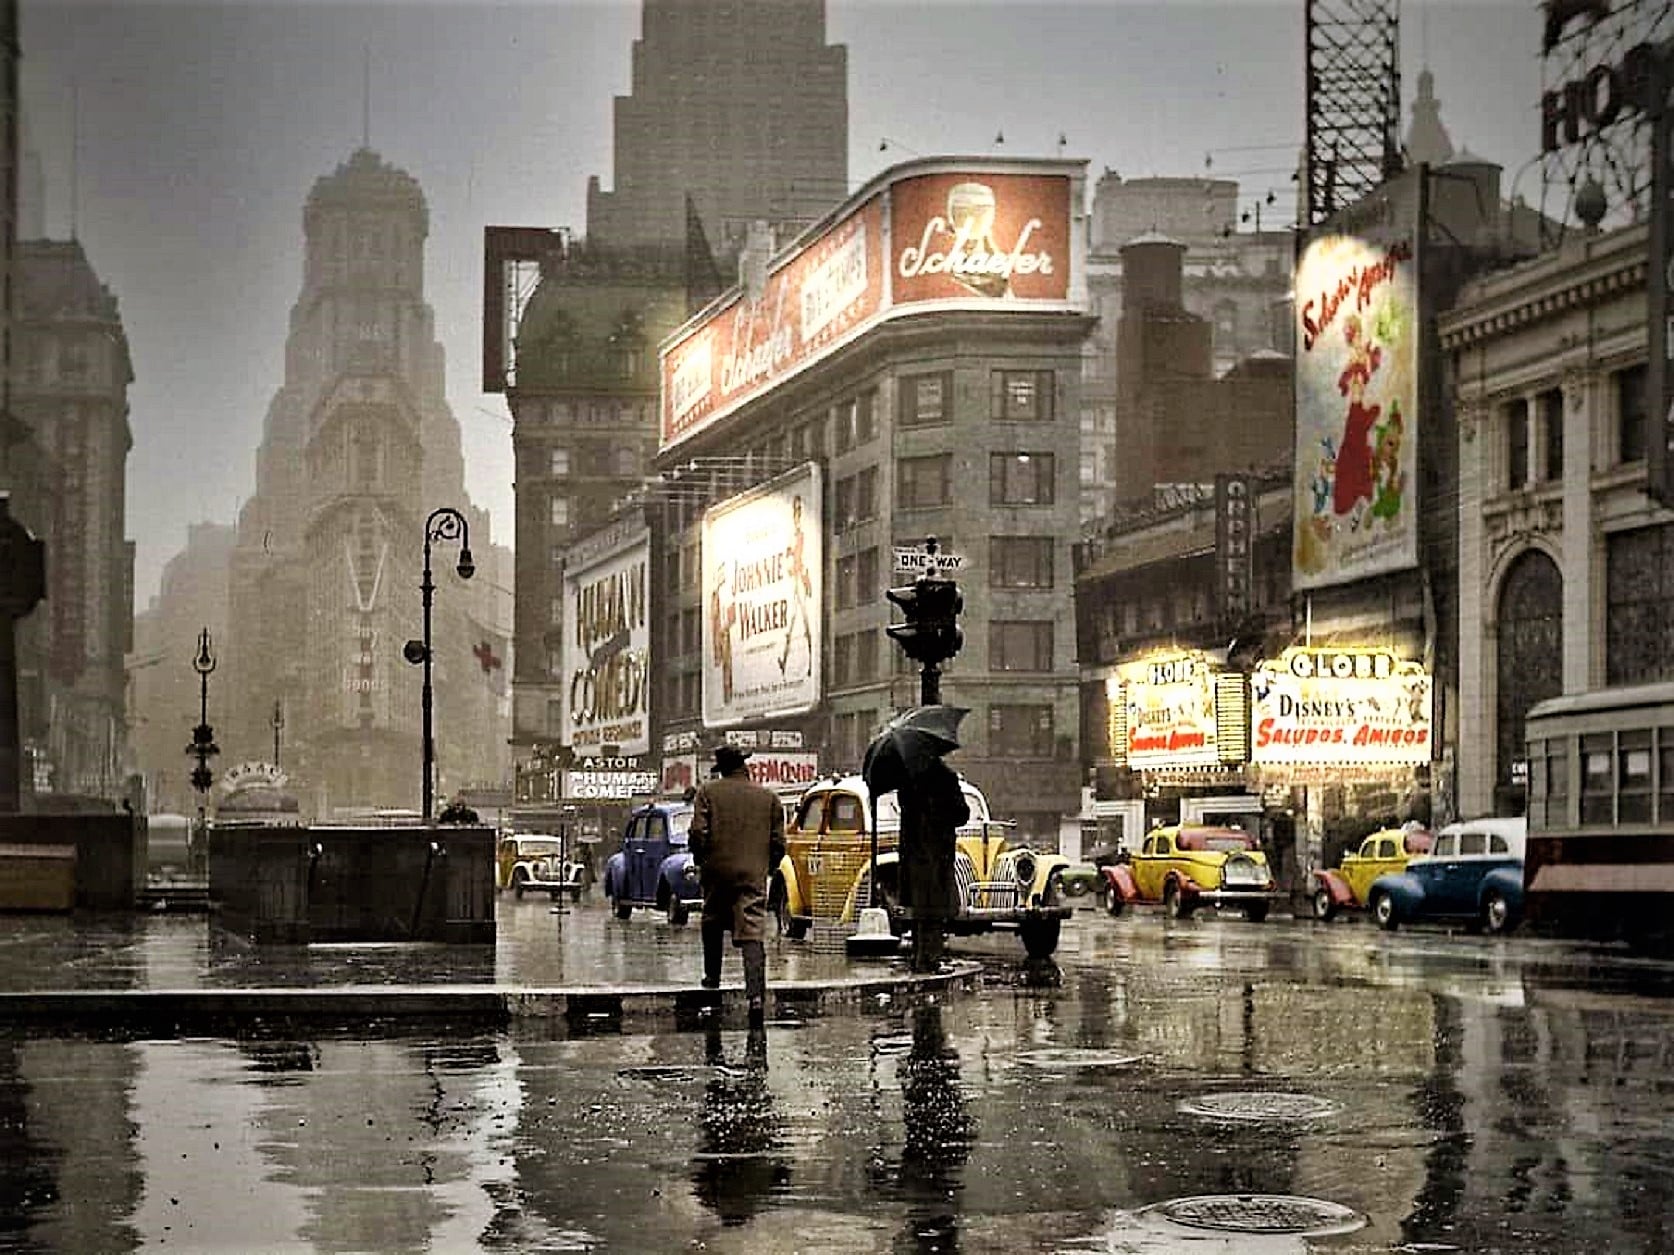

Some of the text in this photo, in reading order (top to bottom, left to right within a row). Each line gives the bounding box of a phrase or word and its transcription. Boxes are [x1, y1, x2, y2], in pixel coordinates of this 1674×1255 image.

[900, 216, 1054, 279] Schaefer
[731, 552, 784, 597] JOHNNIE
[738, 599, 788, 641] WALKER
[1291, 653, 1391, 679] GLOBE
[1280, 694, 1354, 718] DISNEY'S
[1353, 724, 1428, 746] AMIGOS
[584, 757, 637, 768] ASTOR
